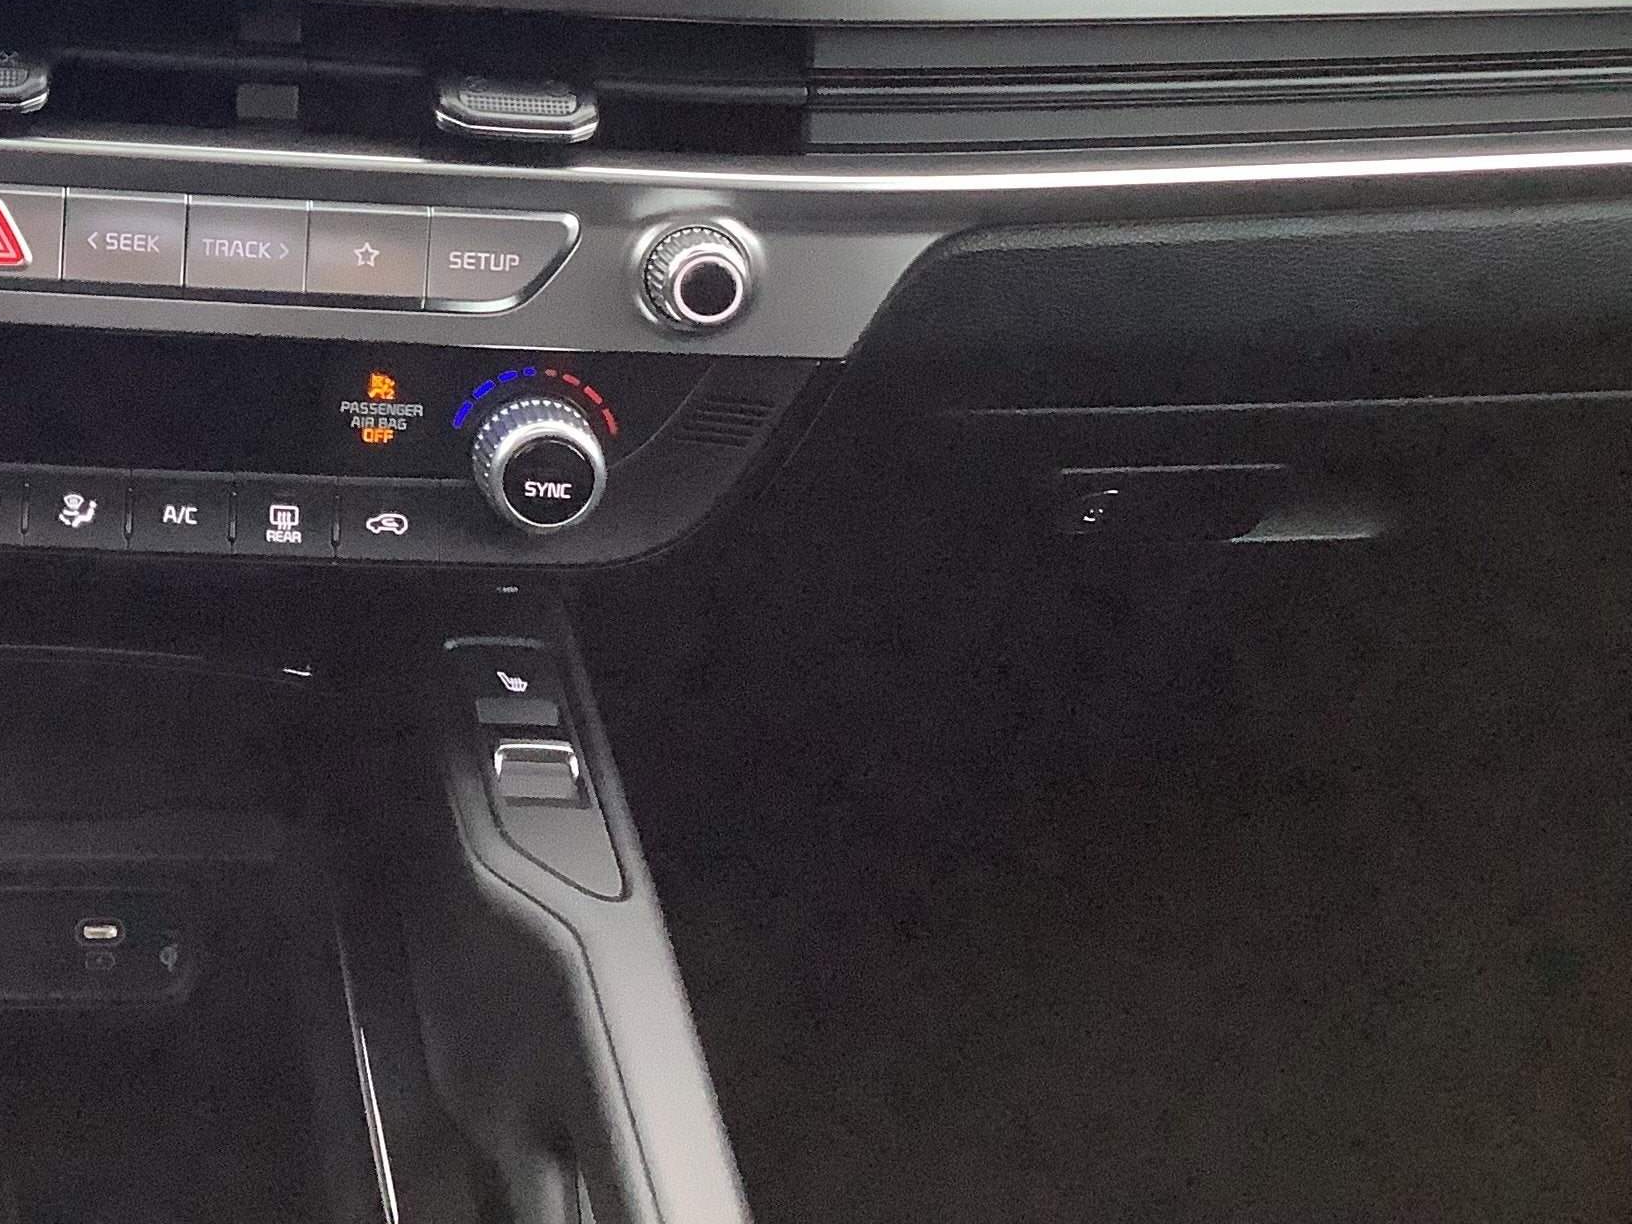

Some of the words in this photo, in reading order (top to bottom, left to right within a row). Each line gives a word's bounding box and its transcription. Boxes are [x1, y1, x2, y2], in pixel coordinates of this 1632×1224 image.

[104, 232, 161, 254] SEEK
[201, 237, 271, 260] TRACK
[447, 251, 520, 272] SETUP
[340, 400, 424, 417] PASSENGER
[350, 416, 375, 429] AIR
[378, 417, 407, 431] BAG
[362, 427, 395, 444] OFF
[524, 480, 572, 501] SYNC
[163, 504, 198, 526] A/C
[265, 528, 302, 544] REAR
